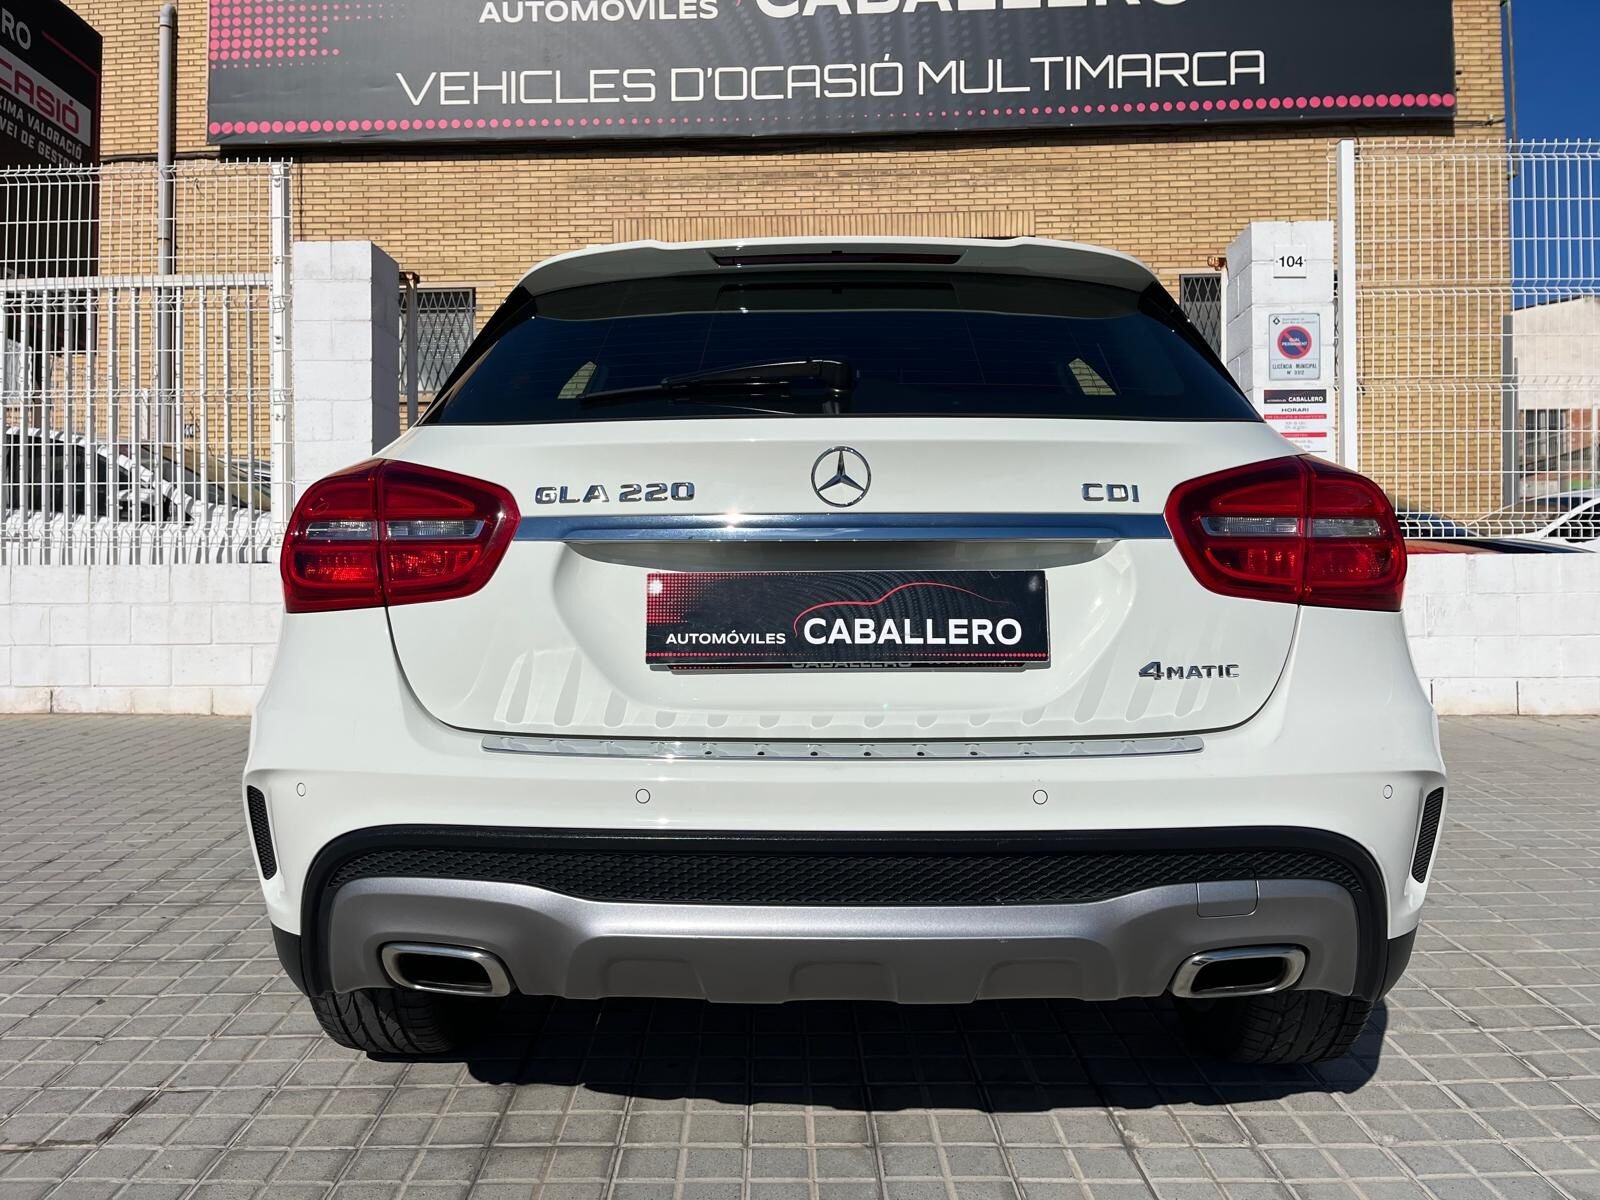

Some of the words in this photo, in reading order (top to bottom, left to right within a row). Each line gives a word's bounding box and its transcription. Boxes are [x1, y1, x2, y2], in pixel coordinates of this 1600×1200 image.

[395, 69, 656, 106] VEHICLES
[670, 54, 903, 102] D'OCASIÓ
[918, 50, 1265, 95] MULTIMARCA
[20, 129, 36, 149] DE
[27, 113, 82, 160] VALORACIÓ
[1279, 255, 1304, 268] 104
[535, 485, 610, 505] GLA
[618, 482, 695, 503] 220
[1082, 483, 1140, 503] CDI
[665, 630, 787, 645] AUTOMÓVILES
[803, 617, 1022, 646] CABALLERO
[1138, 661, 1240, 681] 4MATIC
